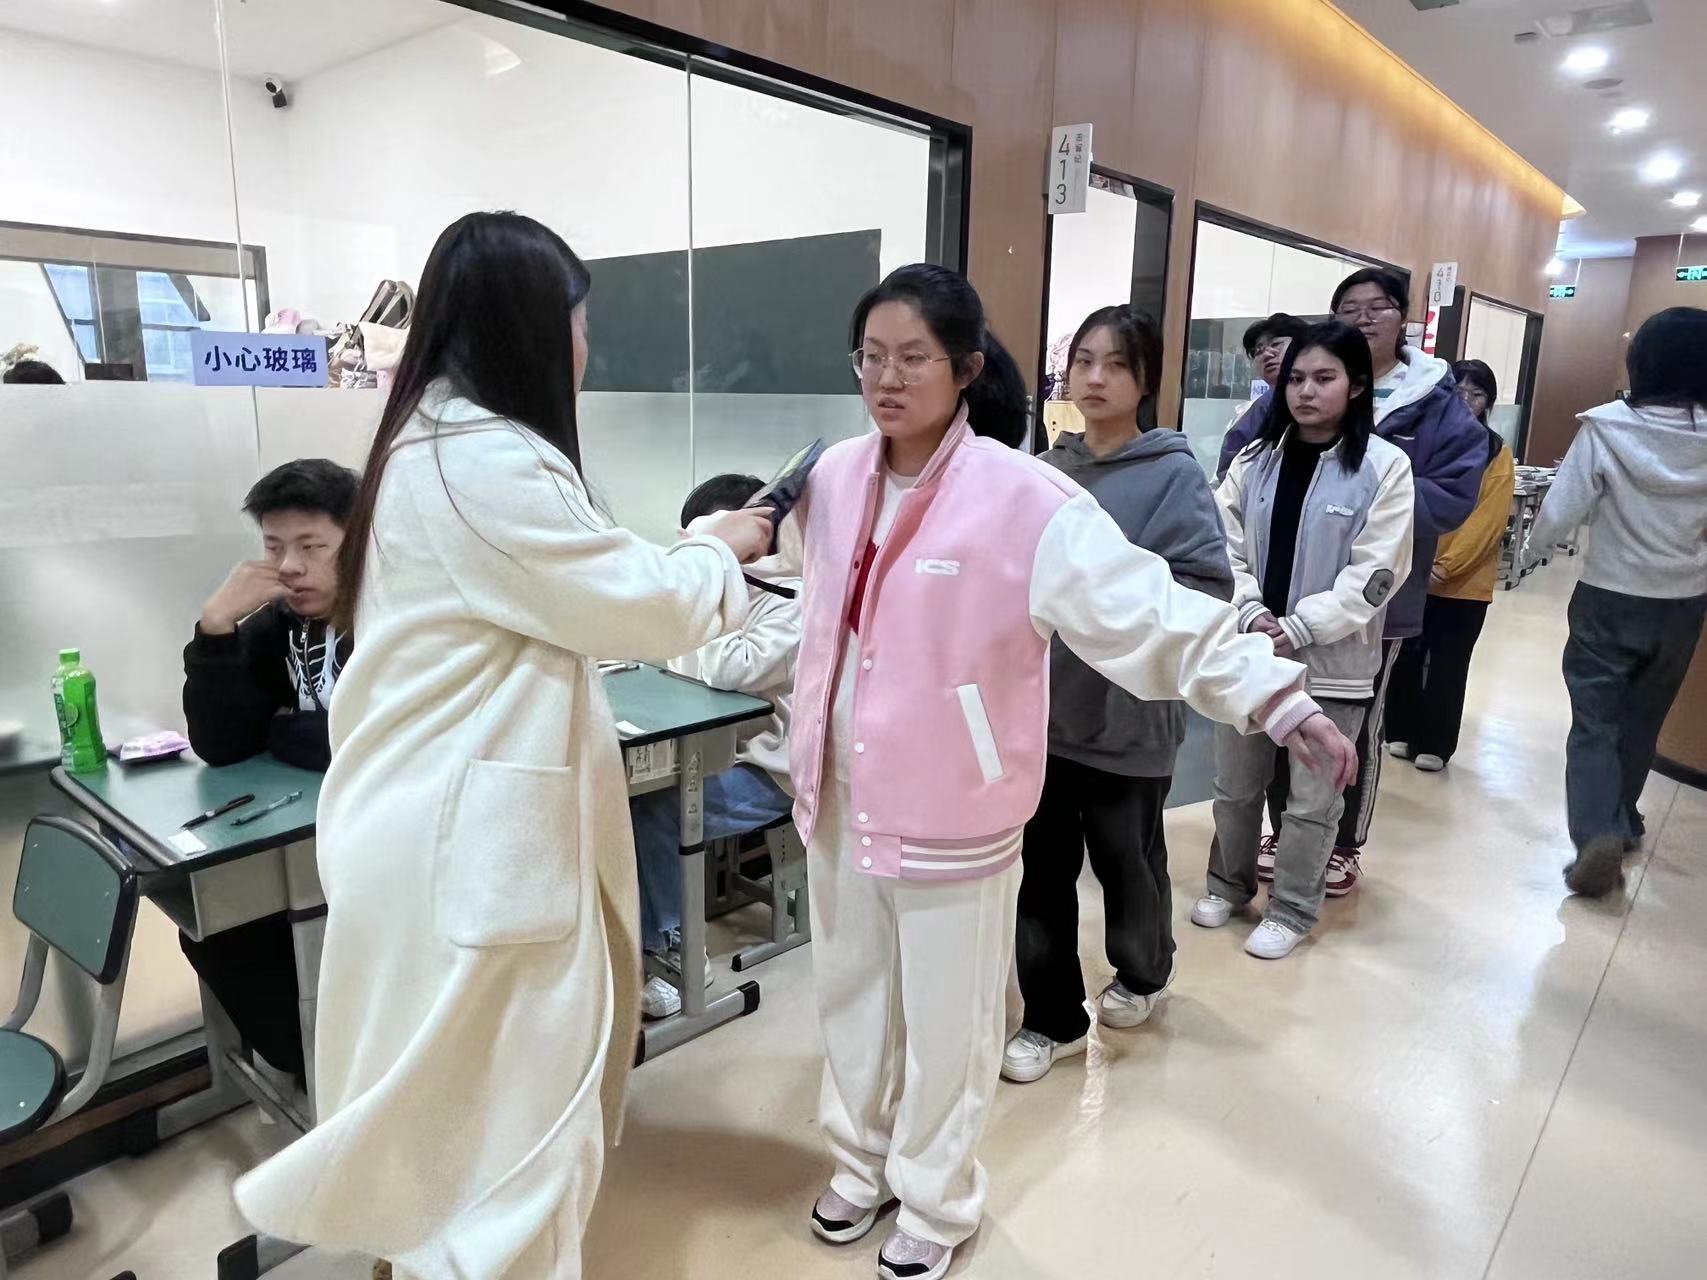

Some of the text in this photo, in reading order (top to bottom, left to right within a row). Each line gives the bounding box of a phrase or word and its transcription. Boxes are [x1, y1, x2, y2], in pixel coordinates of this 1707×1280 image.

[1055, 133, 1070, 205] 413
[204, 345, 317, 373] 小心玻璃
